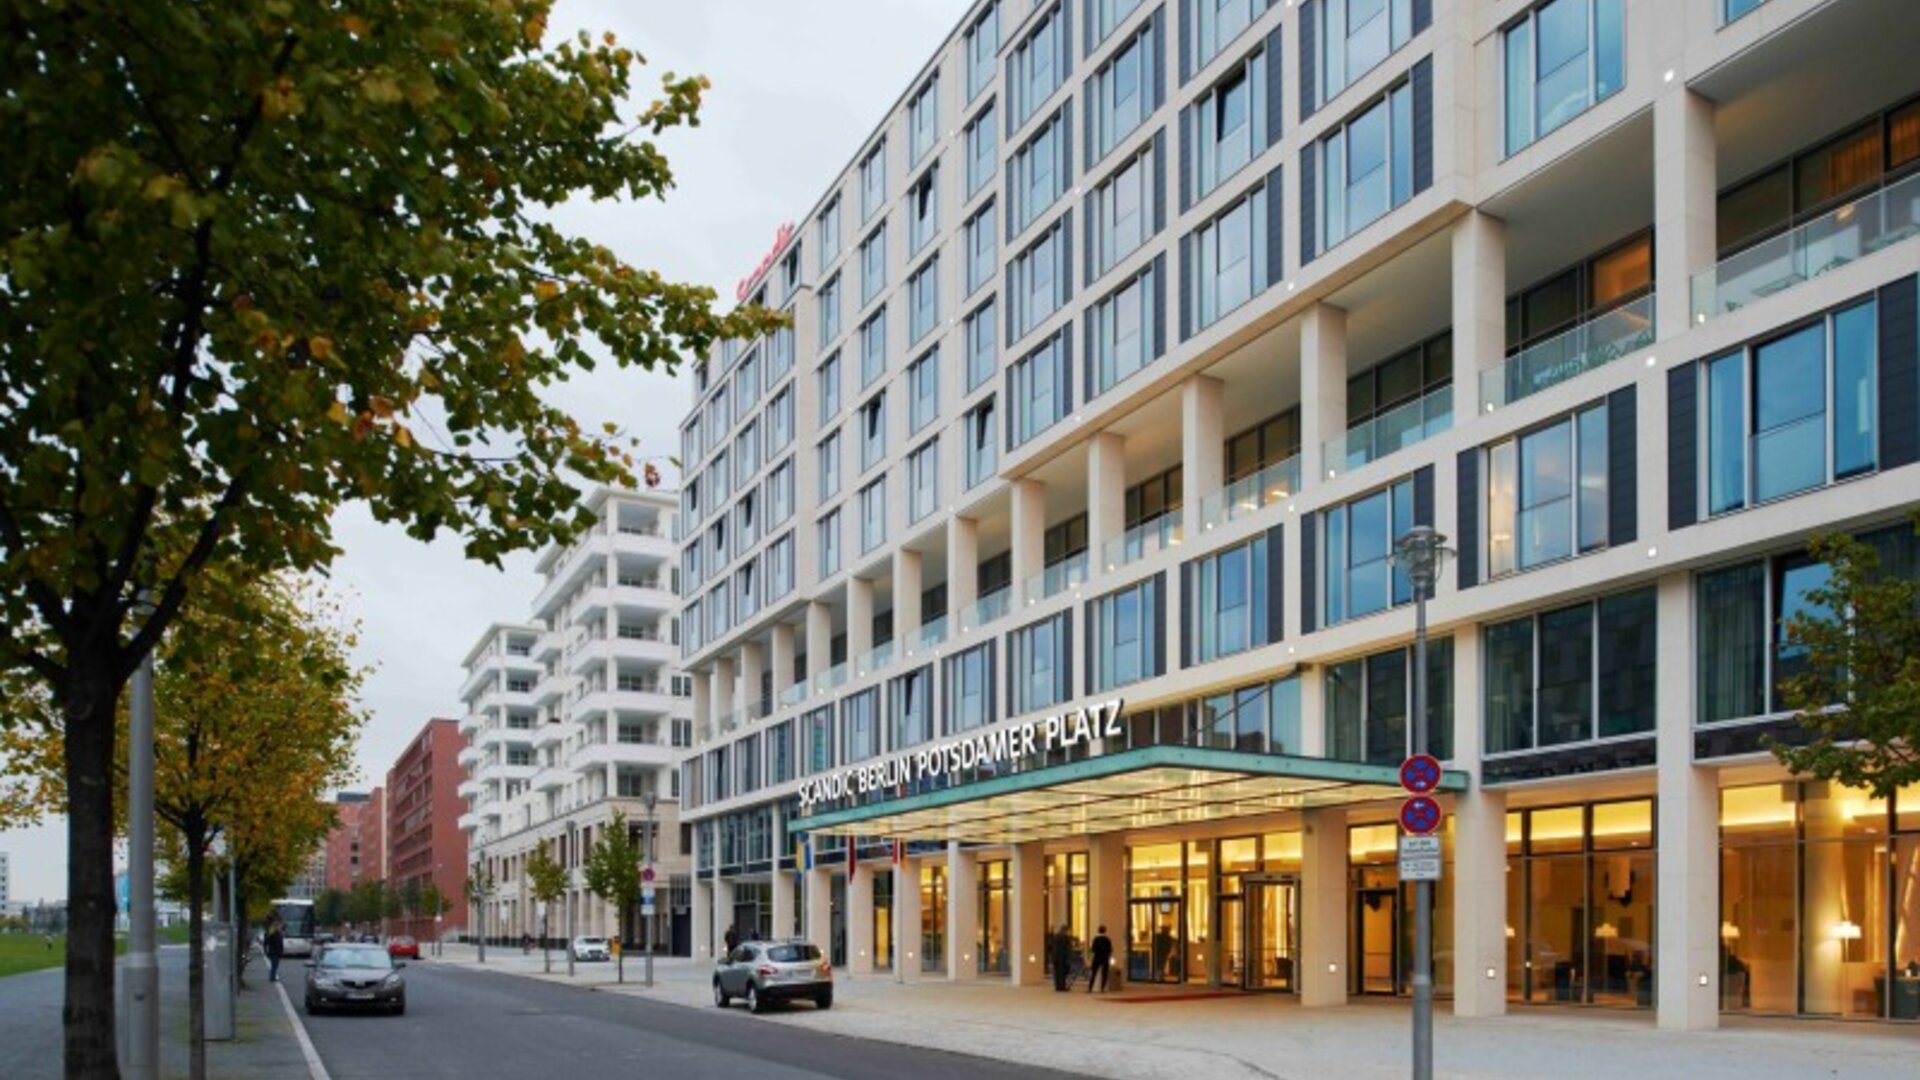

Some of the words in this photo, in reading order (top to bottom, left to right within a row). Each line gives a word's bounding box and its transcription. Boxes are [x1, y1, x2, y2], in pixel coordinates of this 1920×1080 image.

[798, 771, 853, 807] SCANDIC
[858, 755, 911, 793] BERLIN
[916, 725, 1036, 780] POTSDAMER
[1045, 699, 1123, 750] PLATZ
